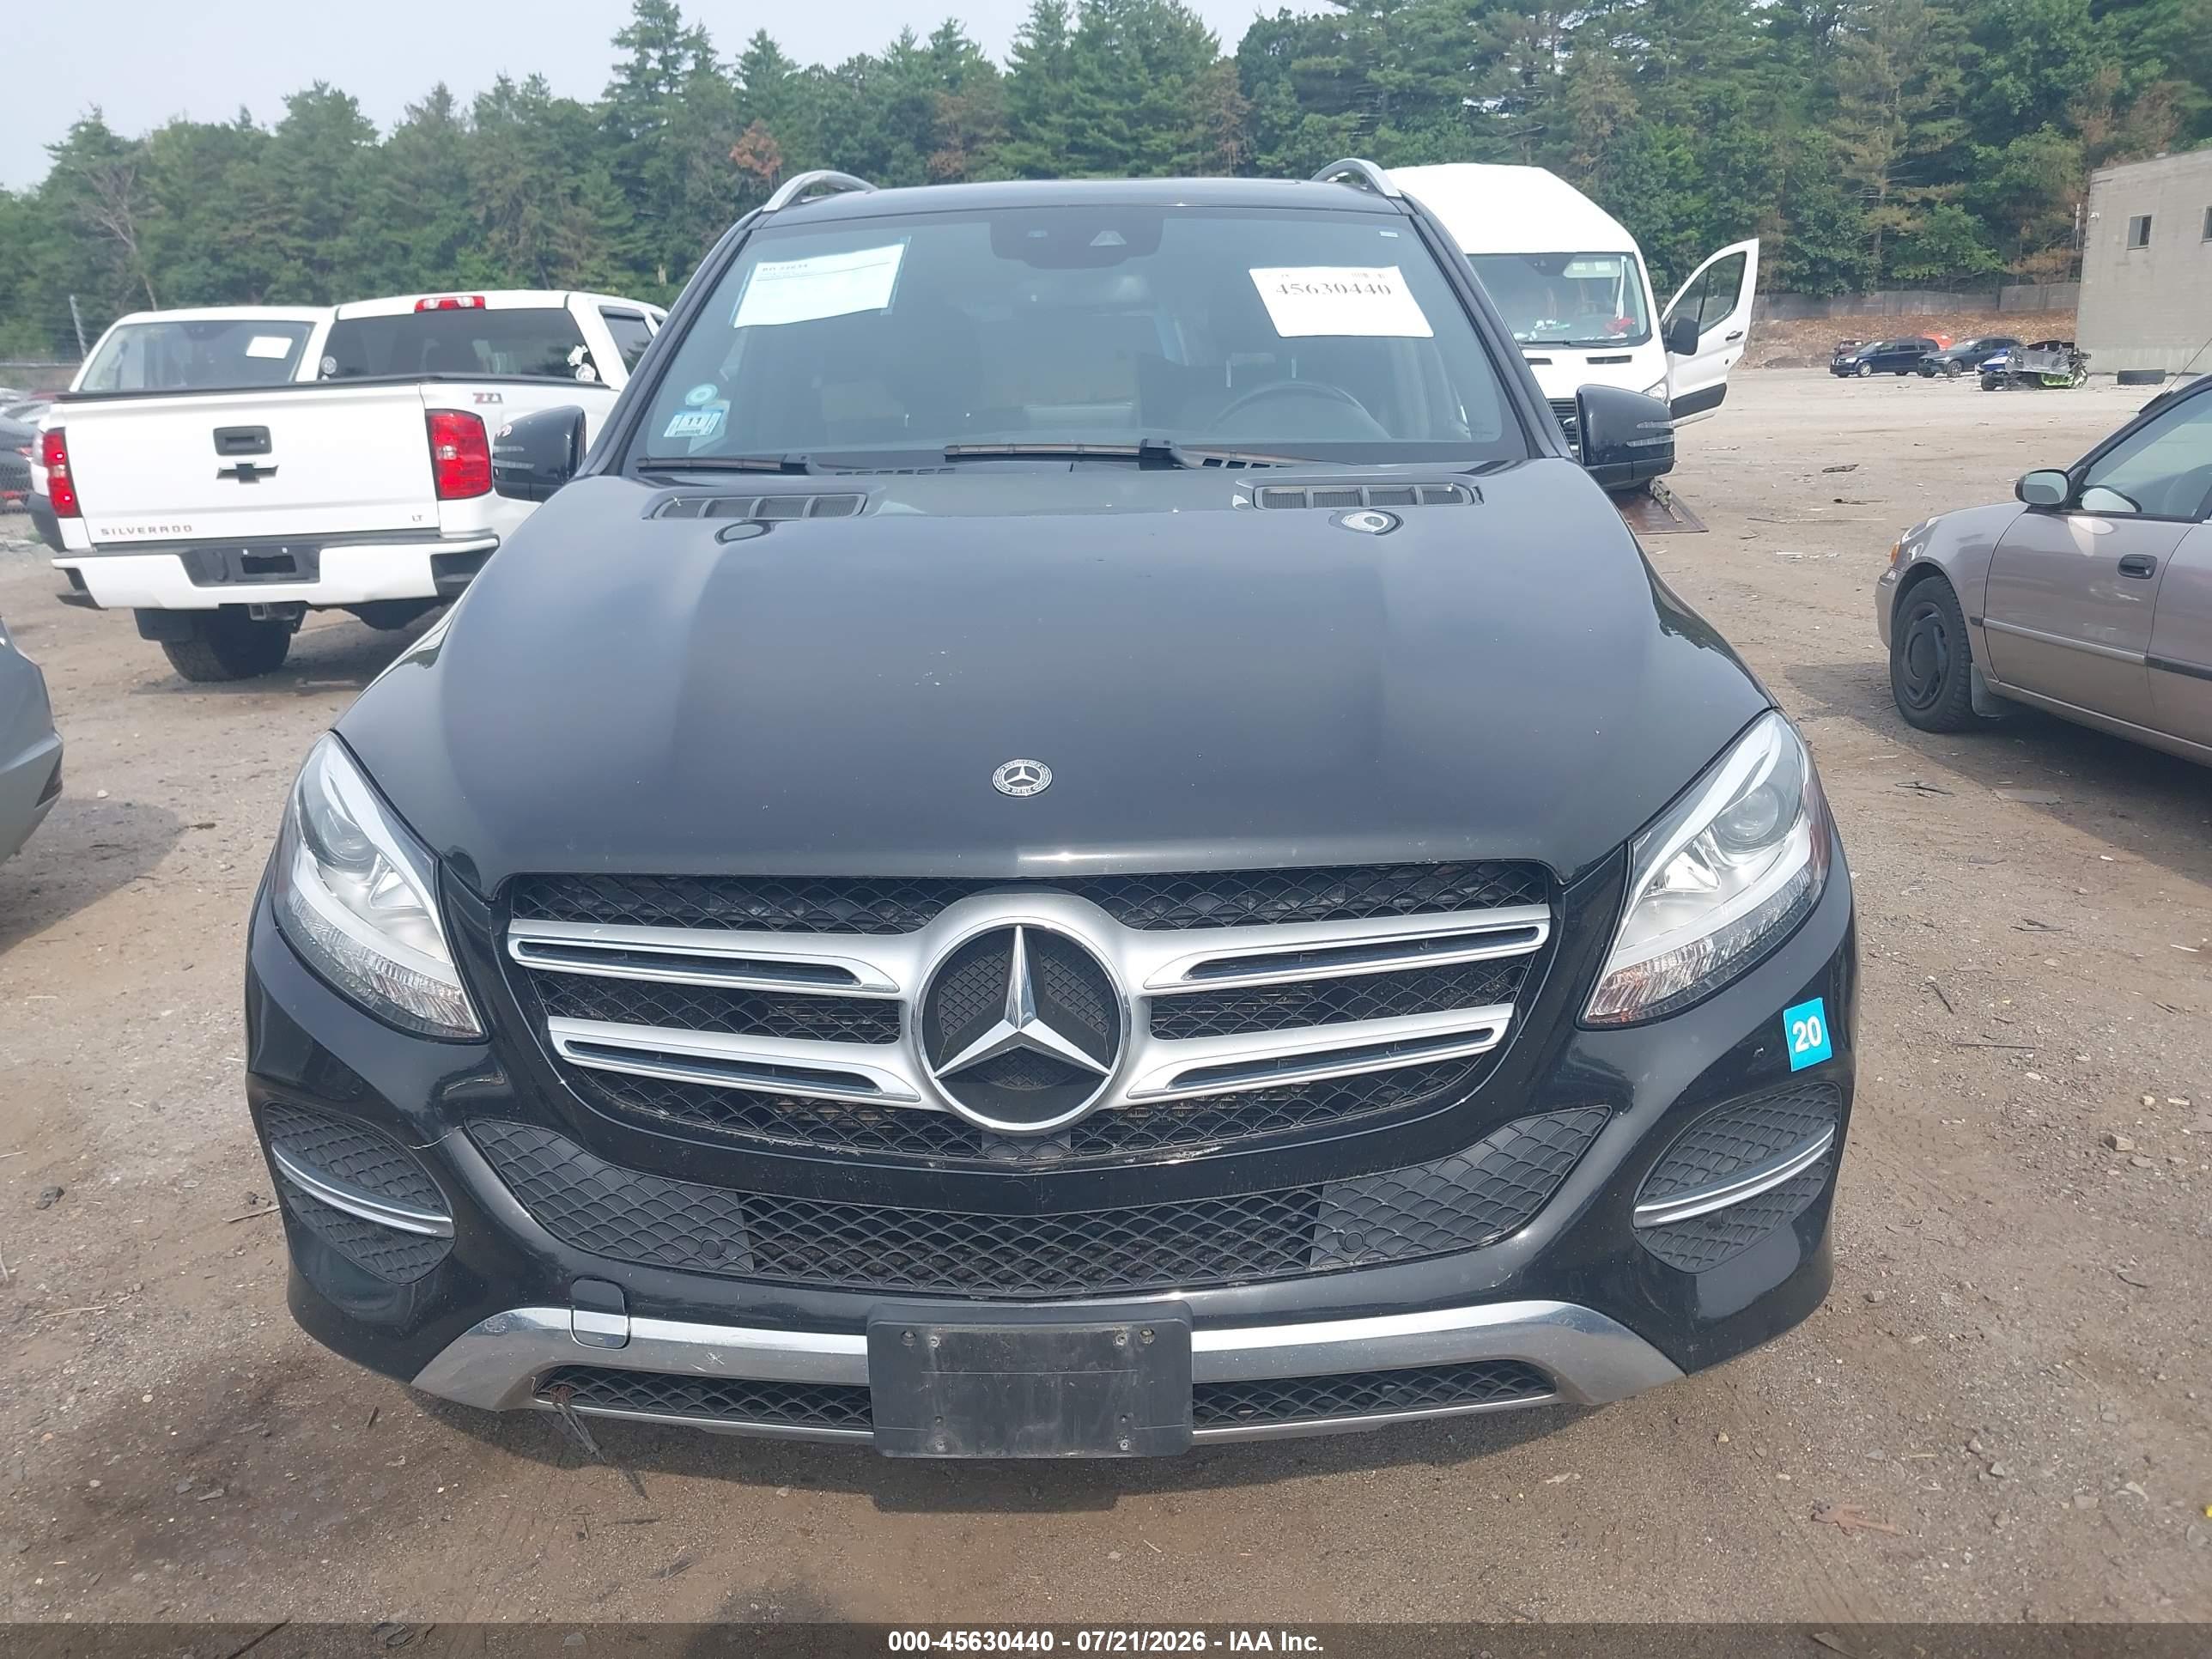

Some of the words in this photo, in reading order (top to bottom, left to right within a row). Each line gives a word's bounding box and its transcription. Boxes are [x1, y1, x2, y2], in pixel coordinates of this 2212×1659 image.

[1276, 283, 1392, 295] 45630440
[100, 525, 192, 536] SILVERADO
[1792, 1016, 1822, 1053] 20
